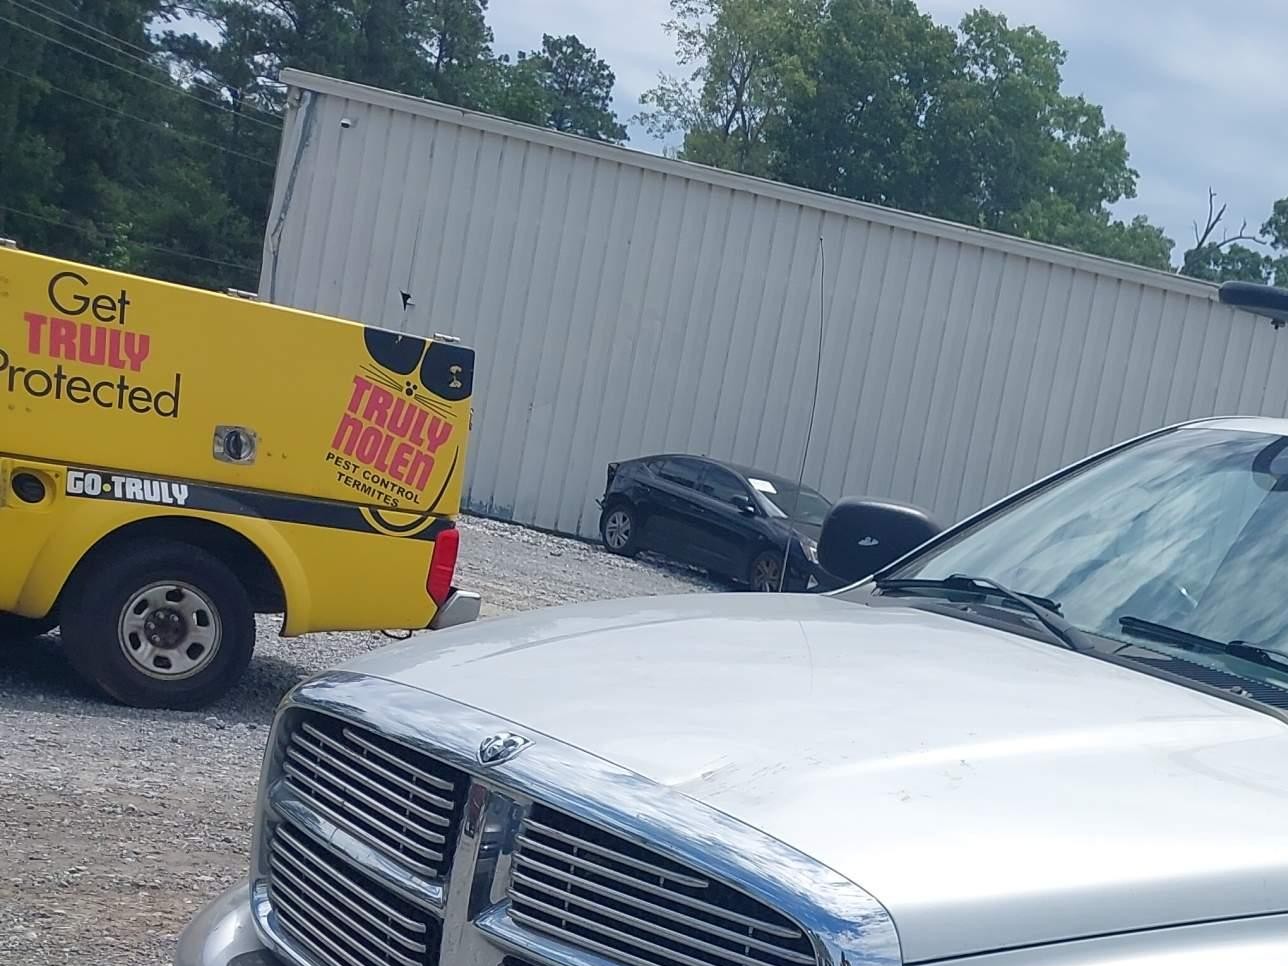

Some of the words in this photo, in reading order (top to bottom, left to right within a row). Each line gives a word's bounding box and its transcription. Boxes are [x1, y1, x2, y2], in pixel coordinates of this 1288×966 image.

[48, 271, 131, 325] Get
[23, 311, 151, 373] TRULY
[347, 375, 454, 454] TRULY
[325, 452, 360, 474] PEST
[362, 470, 421, 505] CONTROL
[331, 413, 436, 492] NOLEN
[336, 471, 400, 508] TERMITES
